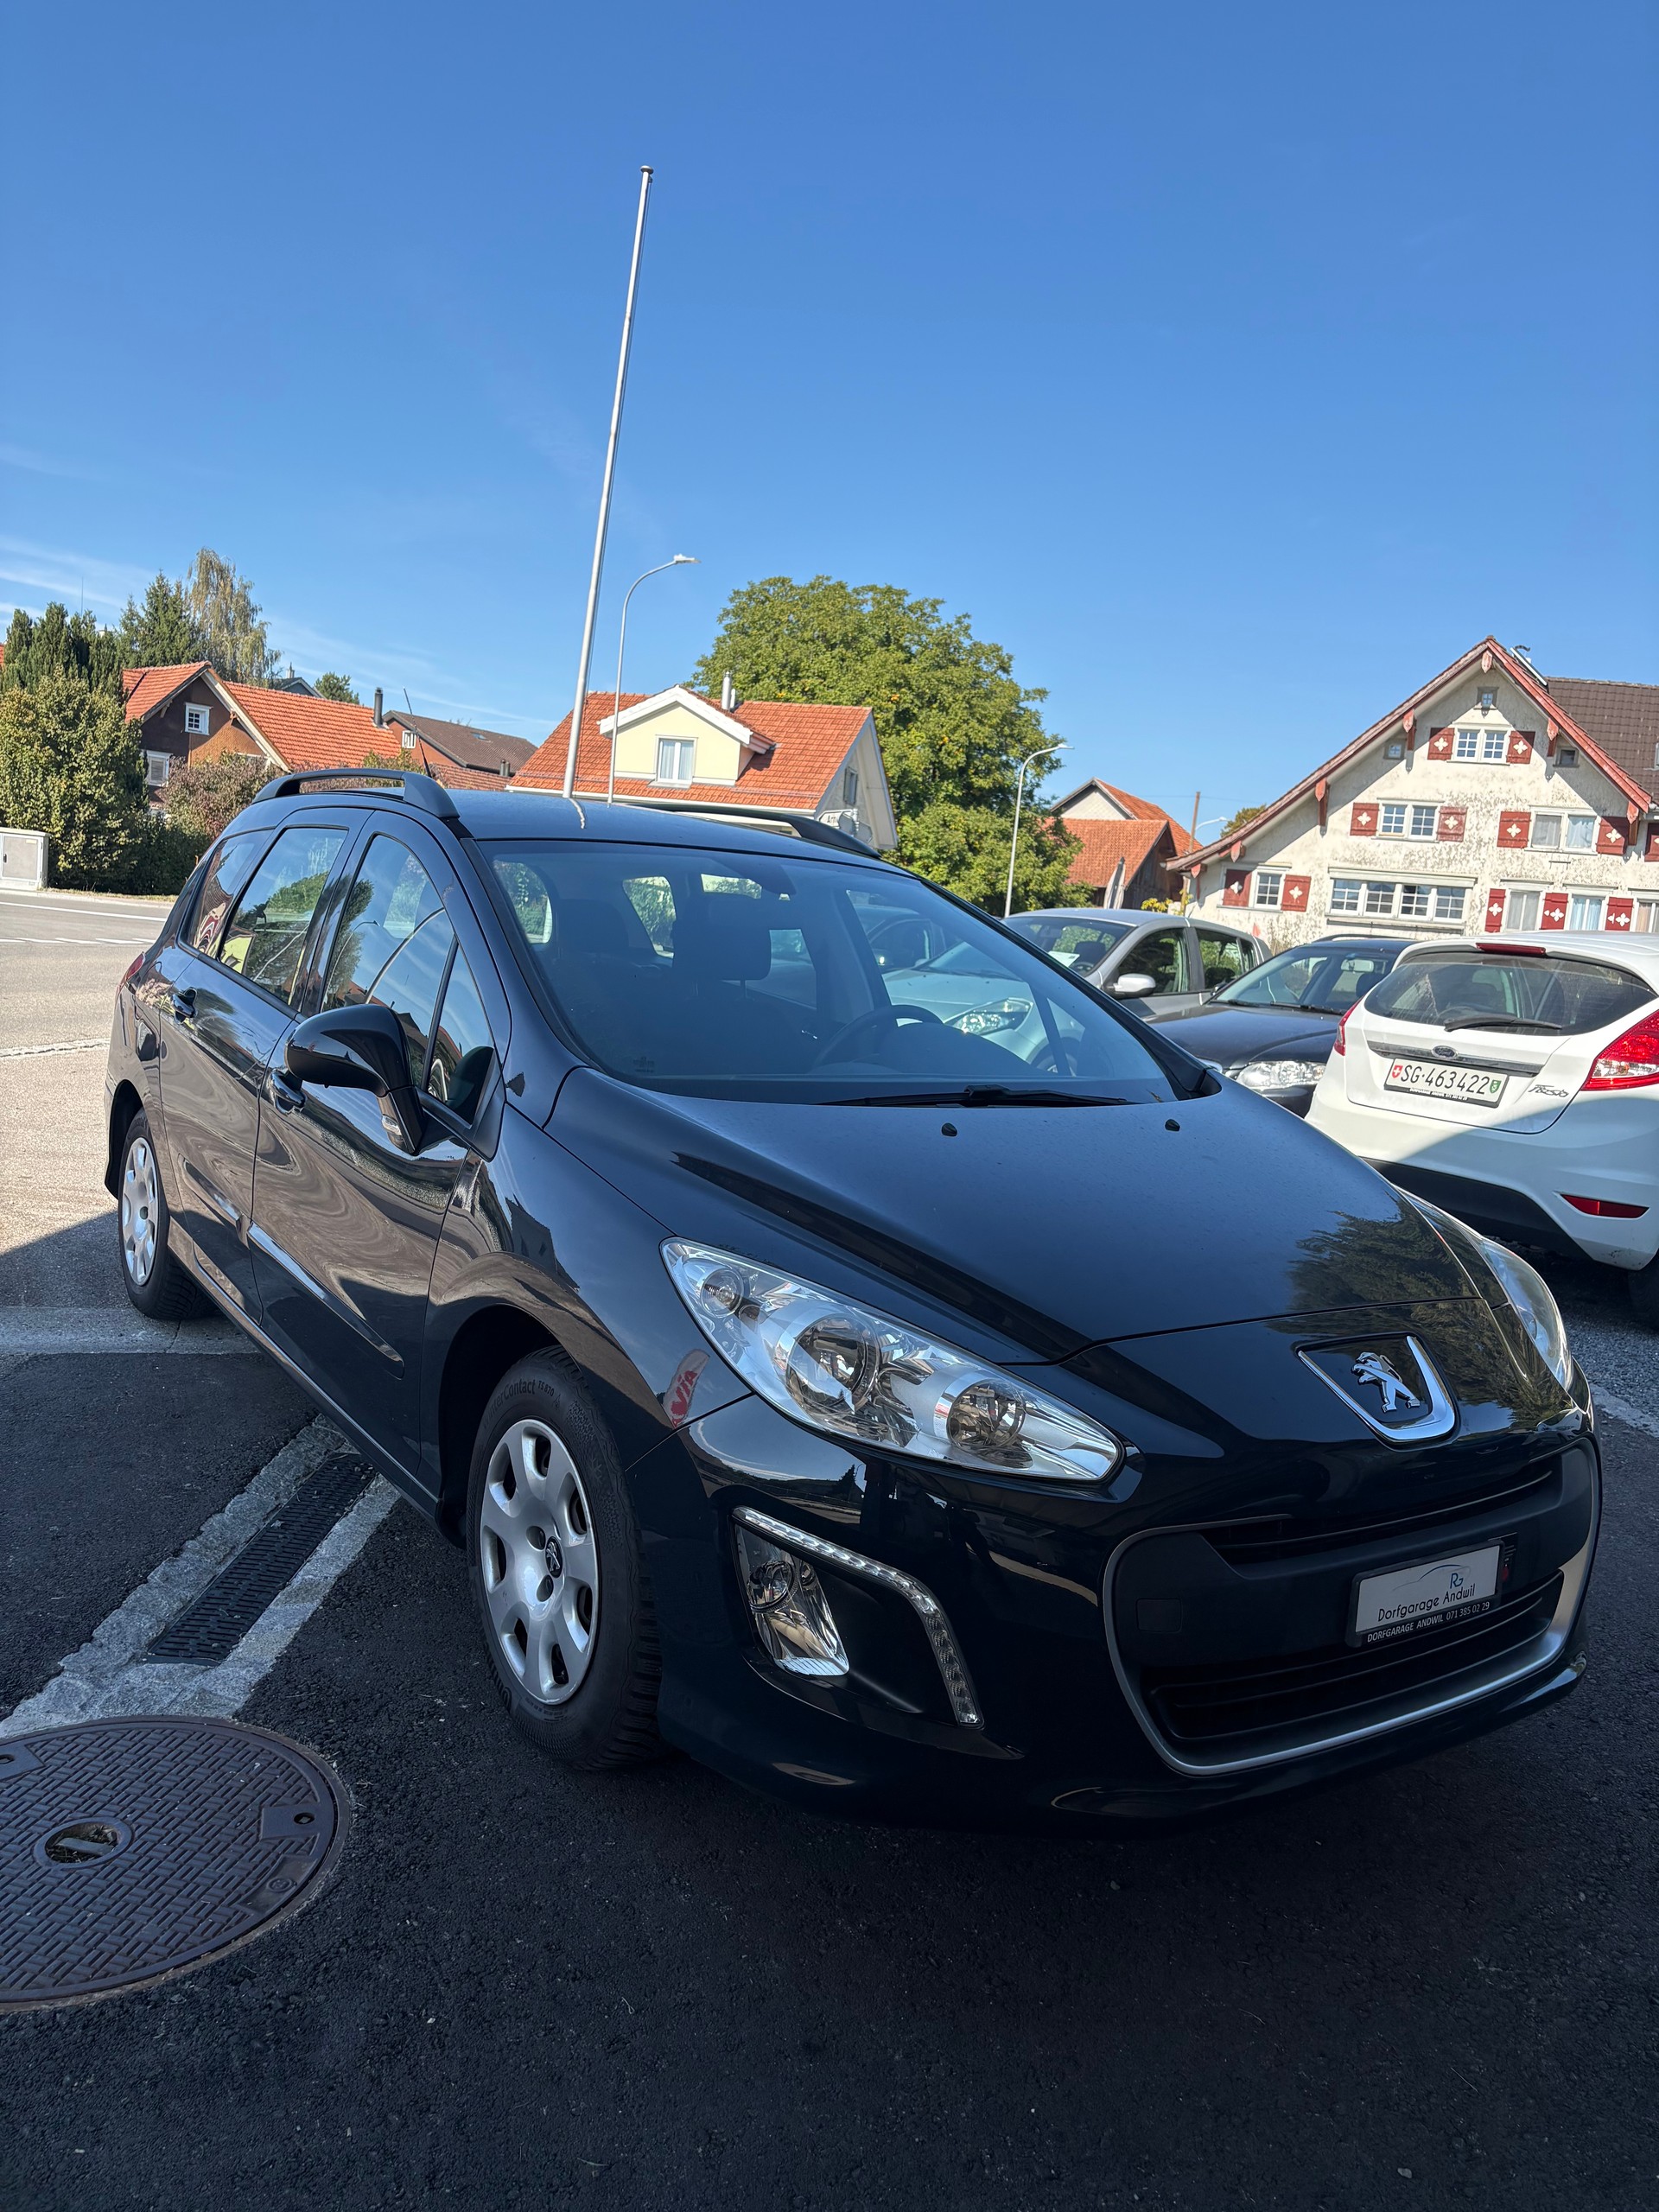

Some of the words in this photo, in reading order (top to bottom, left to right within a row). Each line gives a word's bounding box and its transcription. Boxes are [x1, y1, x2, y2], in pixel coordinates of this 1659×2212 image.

[1367, 1622, 1414, 1643] DORFGARAGE
[1416, 1614, 1444, 1630] ANDWIL
[1446, 1609, 1458, 1621] 071
[1459, 1605, 1471, 1617] 385
[1471, 1604, 1480, 1614] 02
[1481, 1601, 1491, 1611] 29
[1377, 1597, 1440, 1622] Dorfgarage
[1442, 1583, 1476, 1605] Andwil
